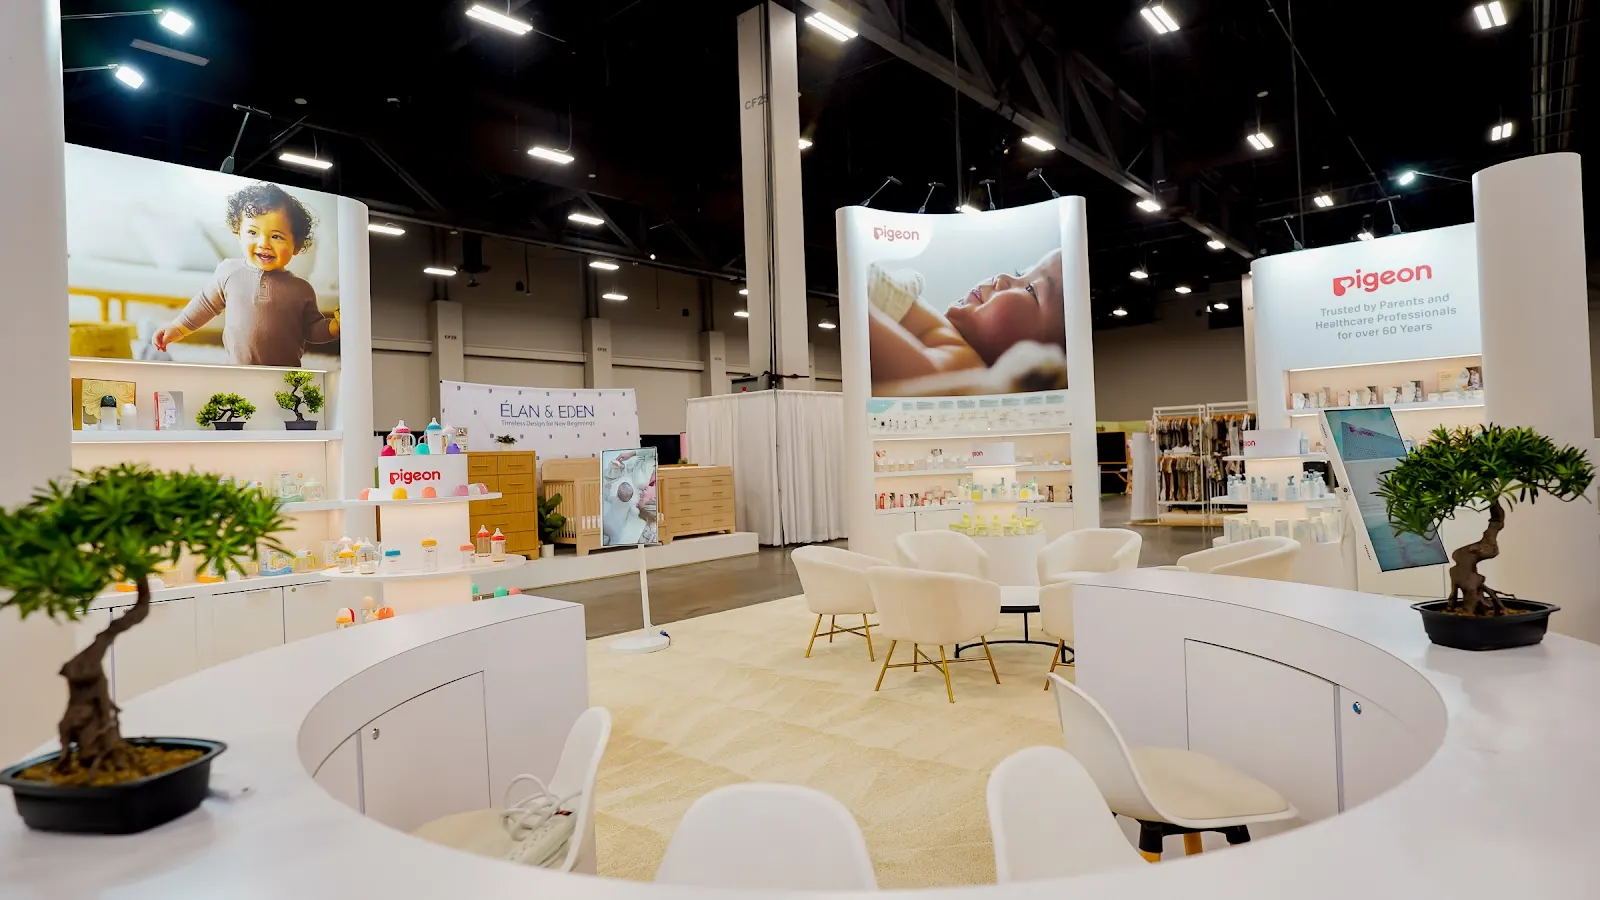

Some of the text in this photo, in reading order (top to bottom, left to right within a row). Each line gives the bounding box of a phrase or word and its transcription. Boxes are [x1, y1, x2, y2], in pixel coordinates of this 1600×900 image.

[1320, 292, 1450, 316] Trusted by Parents and
[1315, 306, 1457, 330] Healthcare Professionals
[1338, 323, 1433, 340] for over 60 Years
[500, 400, 595, 418] ÉLAN & EDEN
[526, 420, 546, 428] Design
[566, 420, 595, 428] Beginnings
